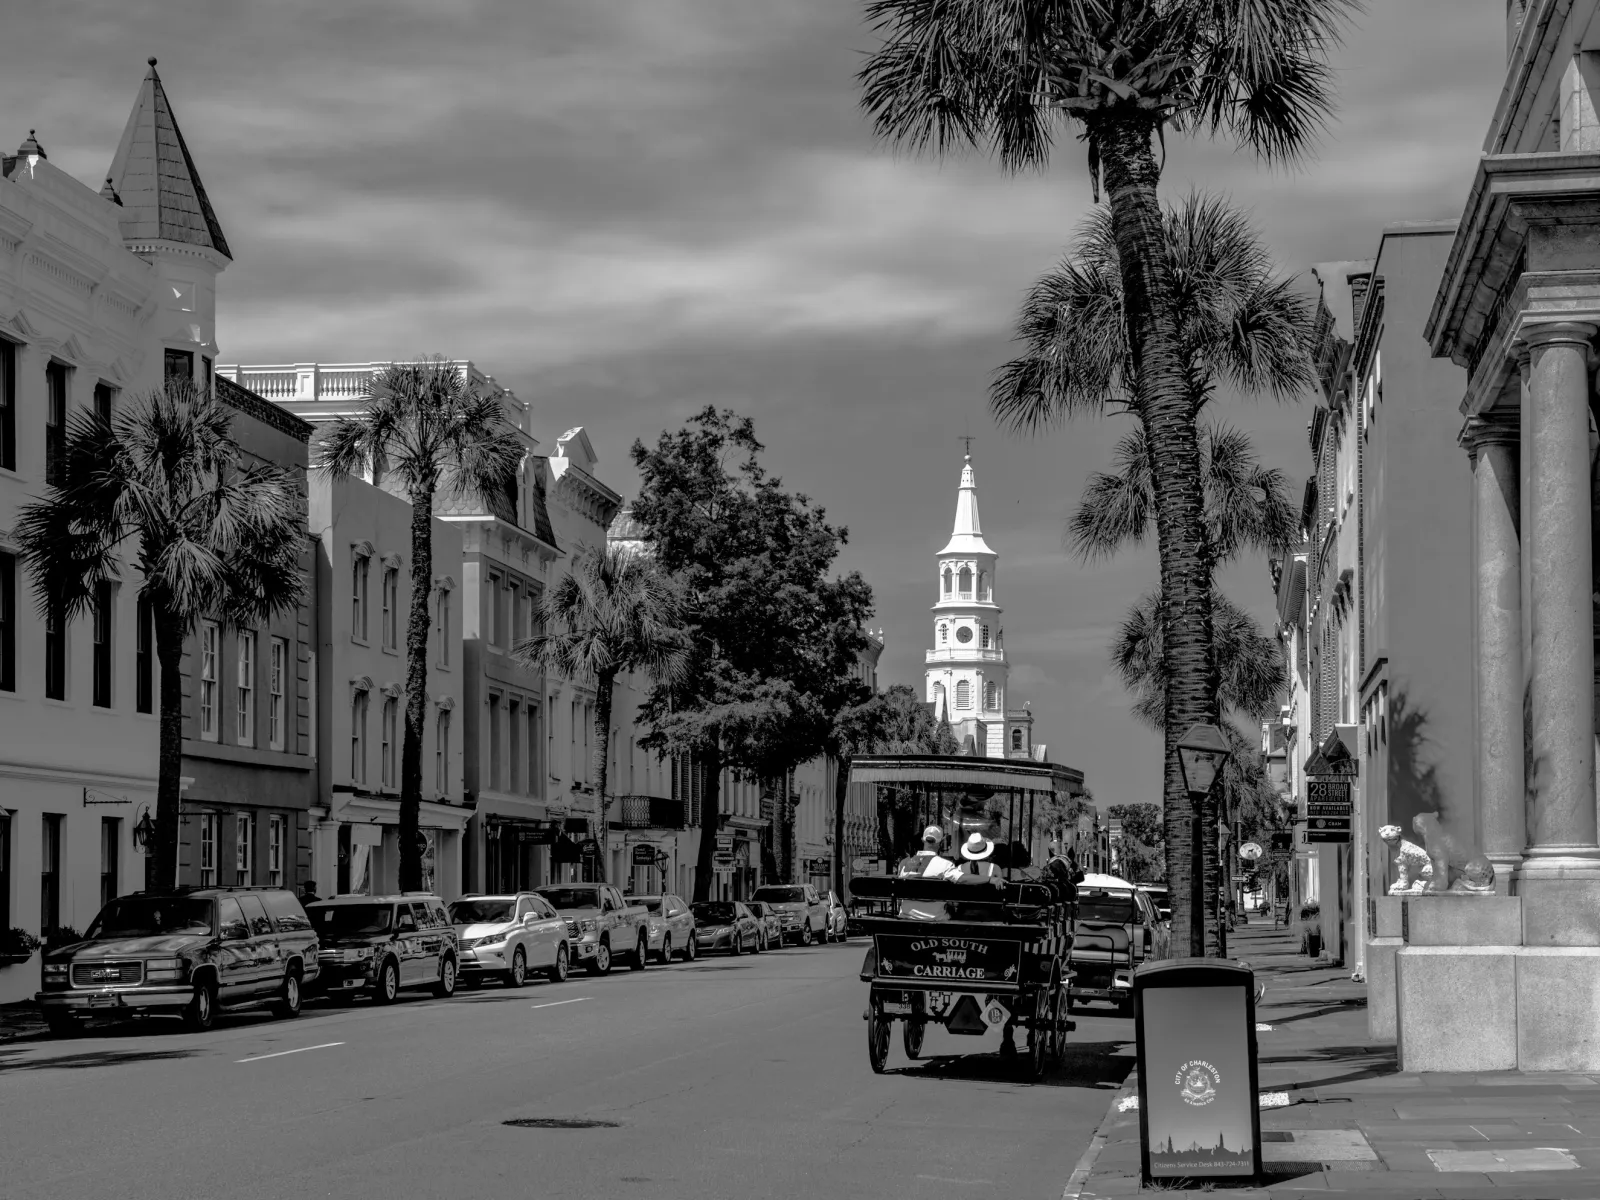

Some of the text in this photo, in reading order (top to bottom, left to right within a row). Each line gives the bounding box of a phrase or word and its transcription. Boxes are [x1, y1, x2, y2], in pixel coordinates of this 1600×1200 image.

[1310, 782, 1327, 796] 28
[910, 938, 989, 955] OLD SOUTH
[90, 968, 120, 978] GMC
[913, 964, 985, 979] CARRIAGE
[1174, 1060, 1221, 1085] CITY OF CHARLESTON
[1153, 1161, 1176, 1169] Citizens
[1177, 1161, 1198, 1169] Service
